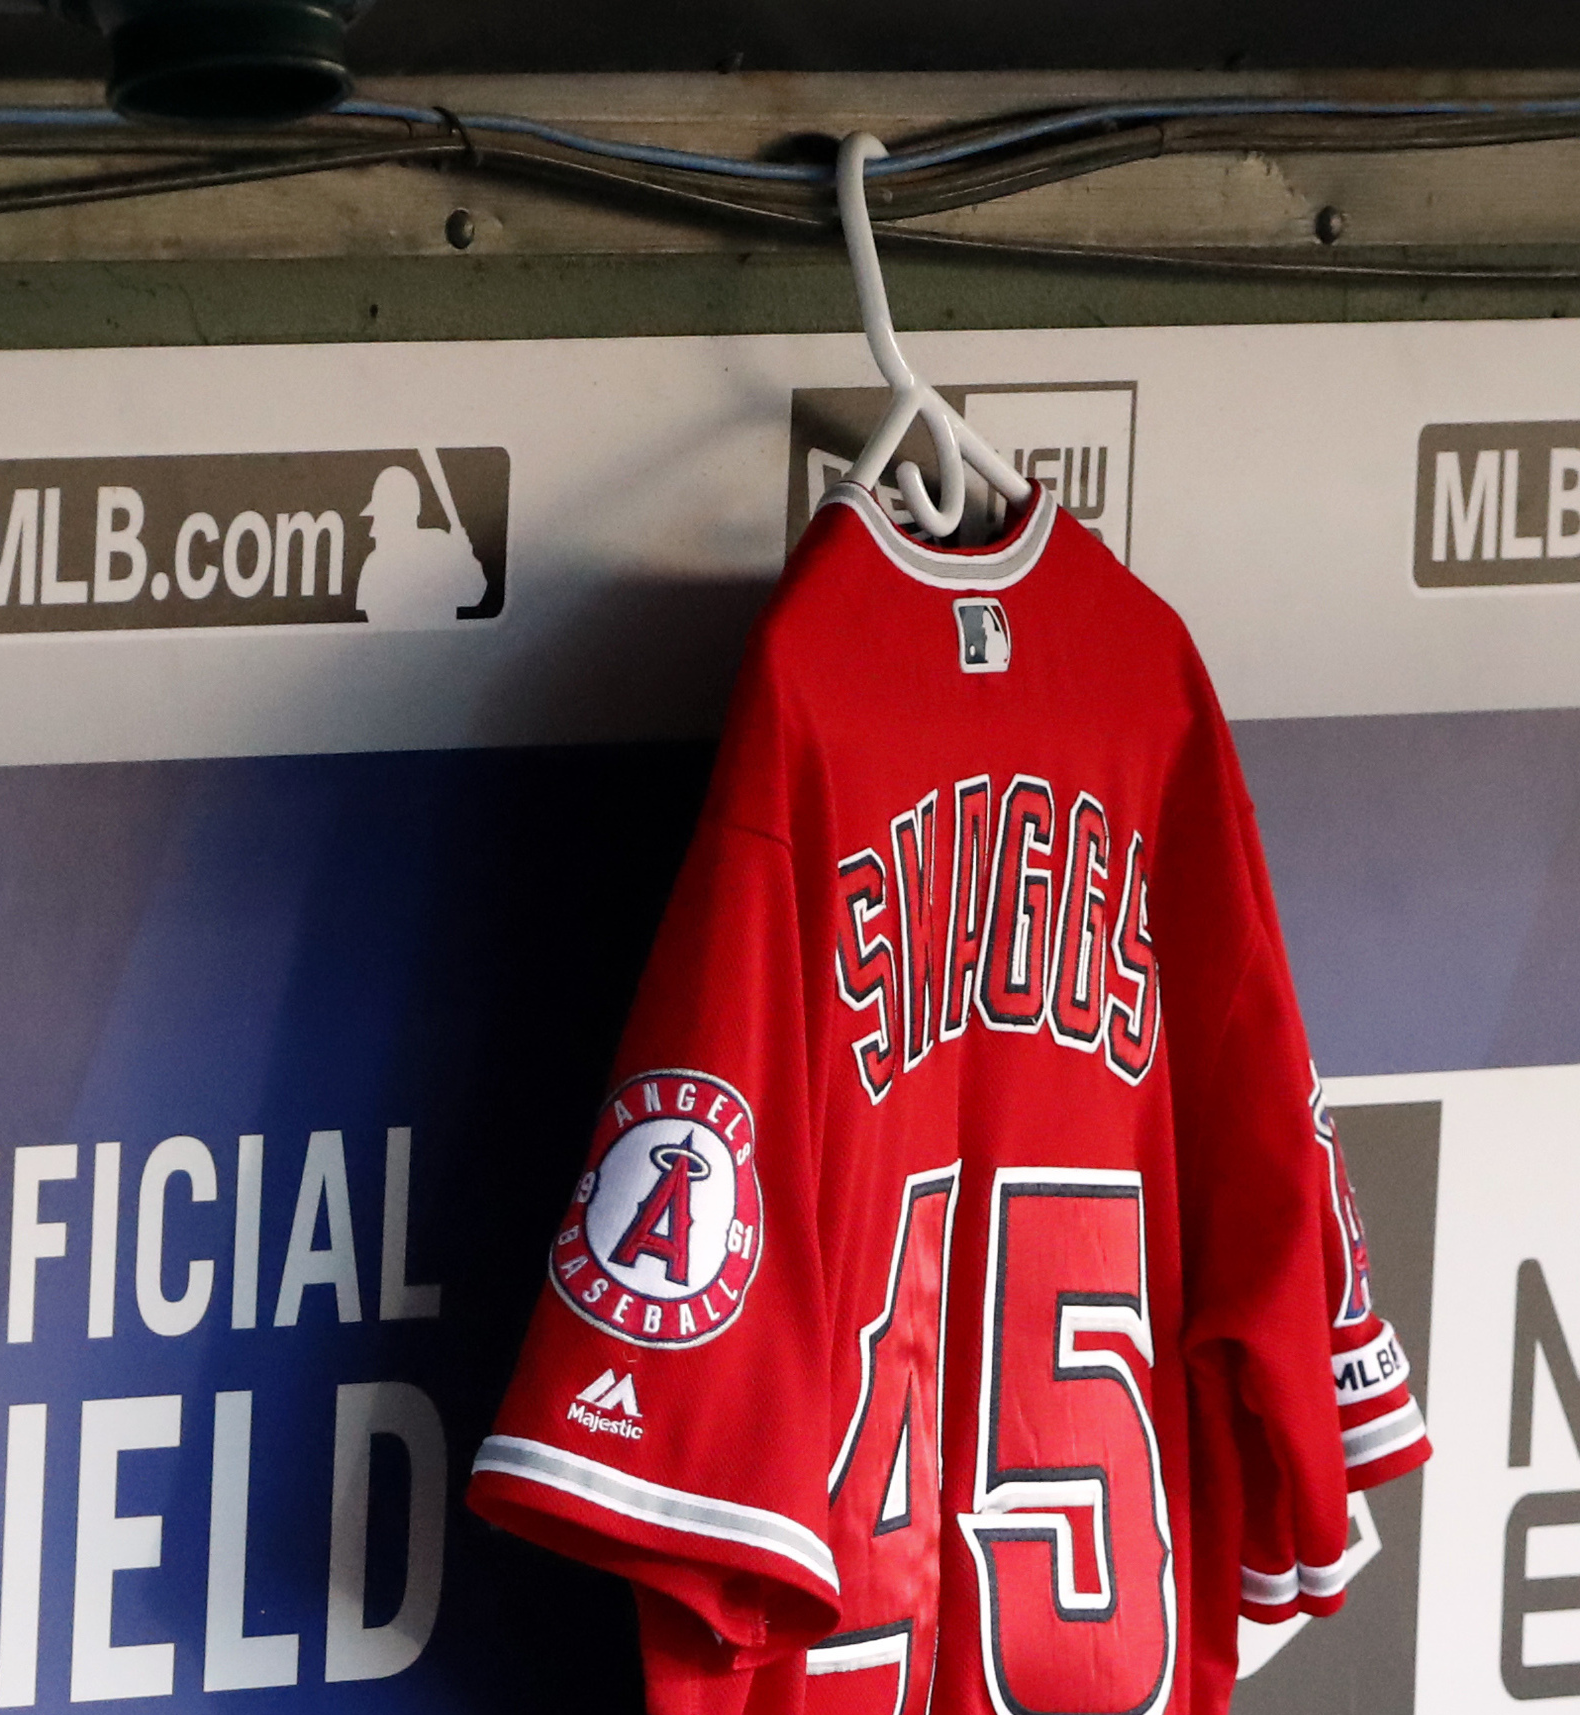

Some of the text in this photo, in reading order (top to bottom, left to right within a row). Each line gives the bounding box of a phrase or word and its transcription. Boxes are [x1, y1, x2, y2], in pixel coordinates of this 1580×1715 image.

[613, 1082, 753, 1167] ANGELS
[557, 1225, 739, 1336] BASEBALL
[566, 1401, 644, 1441] Majestic
